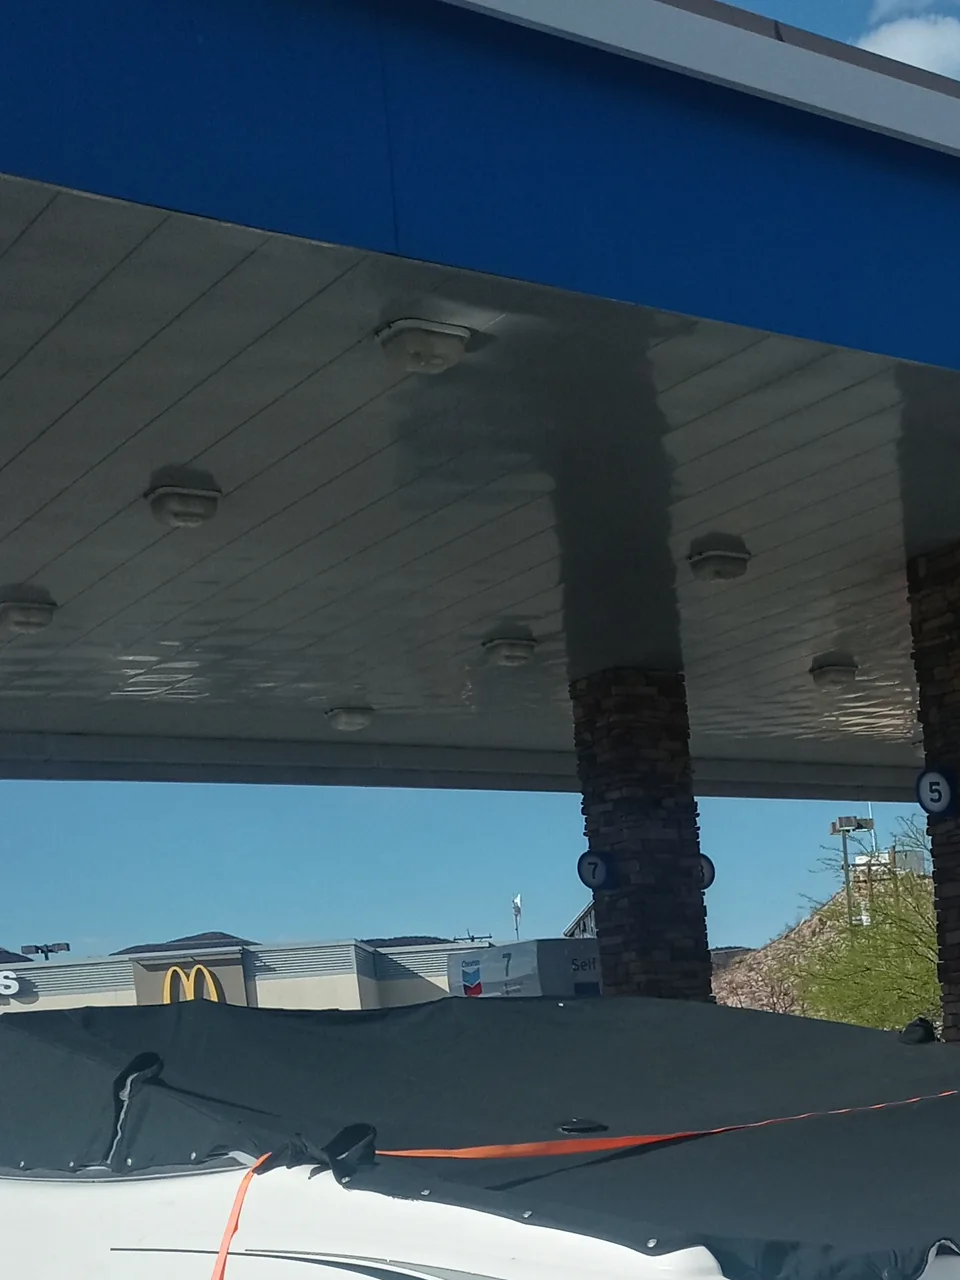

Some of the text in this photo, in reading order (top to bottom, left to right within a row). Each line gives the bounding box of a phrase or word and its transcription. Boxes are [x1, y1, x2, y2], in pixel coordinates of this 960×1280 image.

[928, 781, 942, 803] 5
[588, 861, 598, 880] 7
[502, 952, 512, 977] 7
[572, 957, 596, 971] Self
